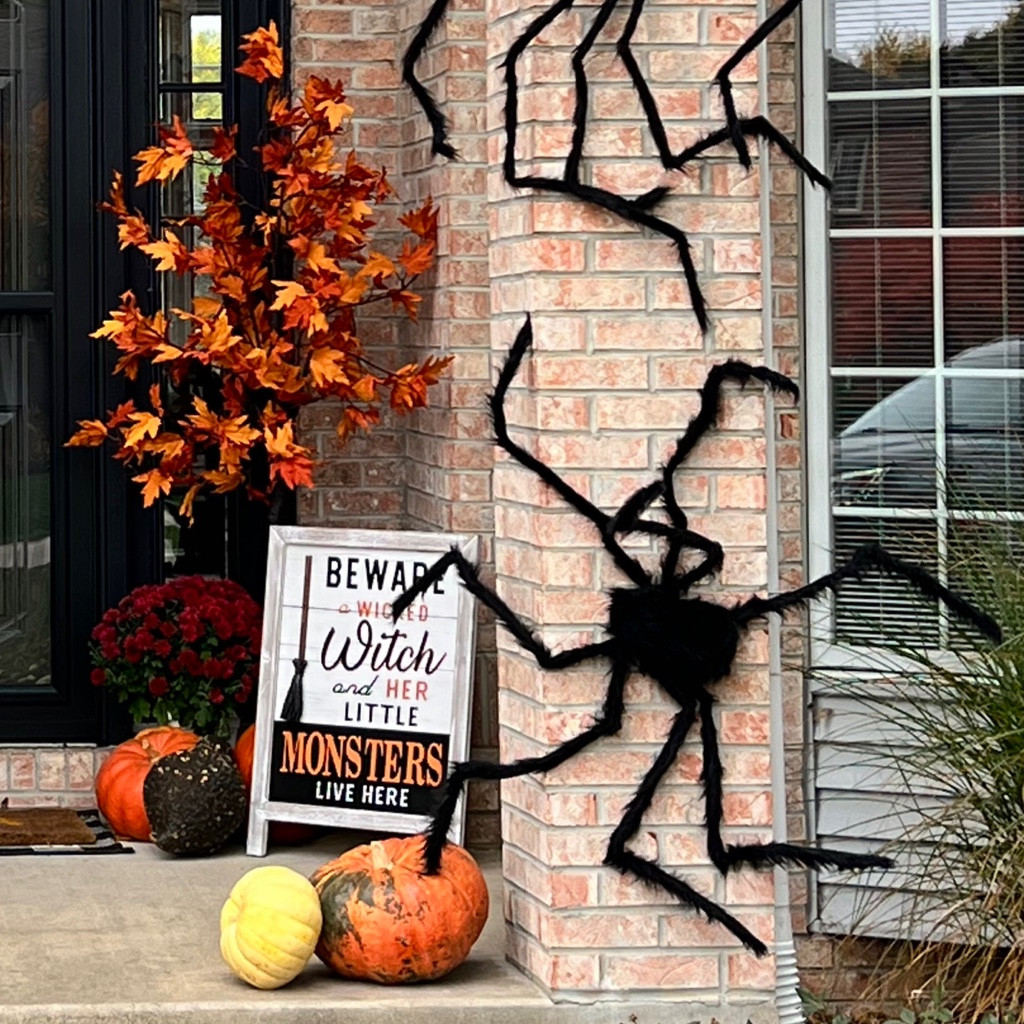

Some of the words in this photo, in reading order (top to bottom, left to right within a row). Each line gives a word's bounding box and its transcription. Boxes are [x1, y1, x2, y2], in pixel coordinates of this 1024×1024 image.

[356, 600, 429, 622] WICED
[321, 619, 447, 675] Witch
[332, 676, 378, 696] and
[386, 680, 428, 701] HER
[344, 701, 419, 726] LITTLE
[279, 731, 443, 787] MONSTERS
[315, 781, 354, 803] LIVE
[361, 785, 409, 808] HERE
